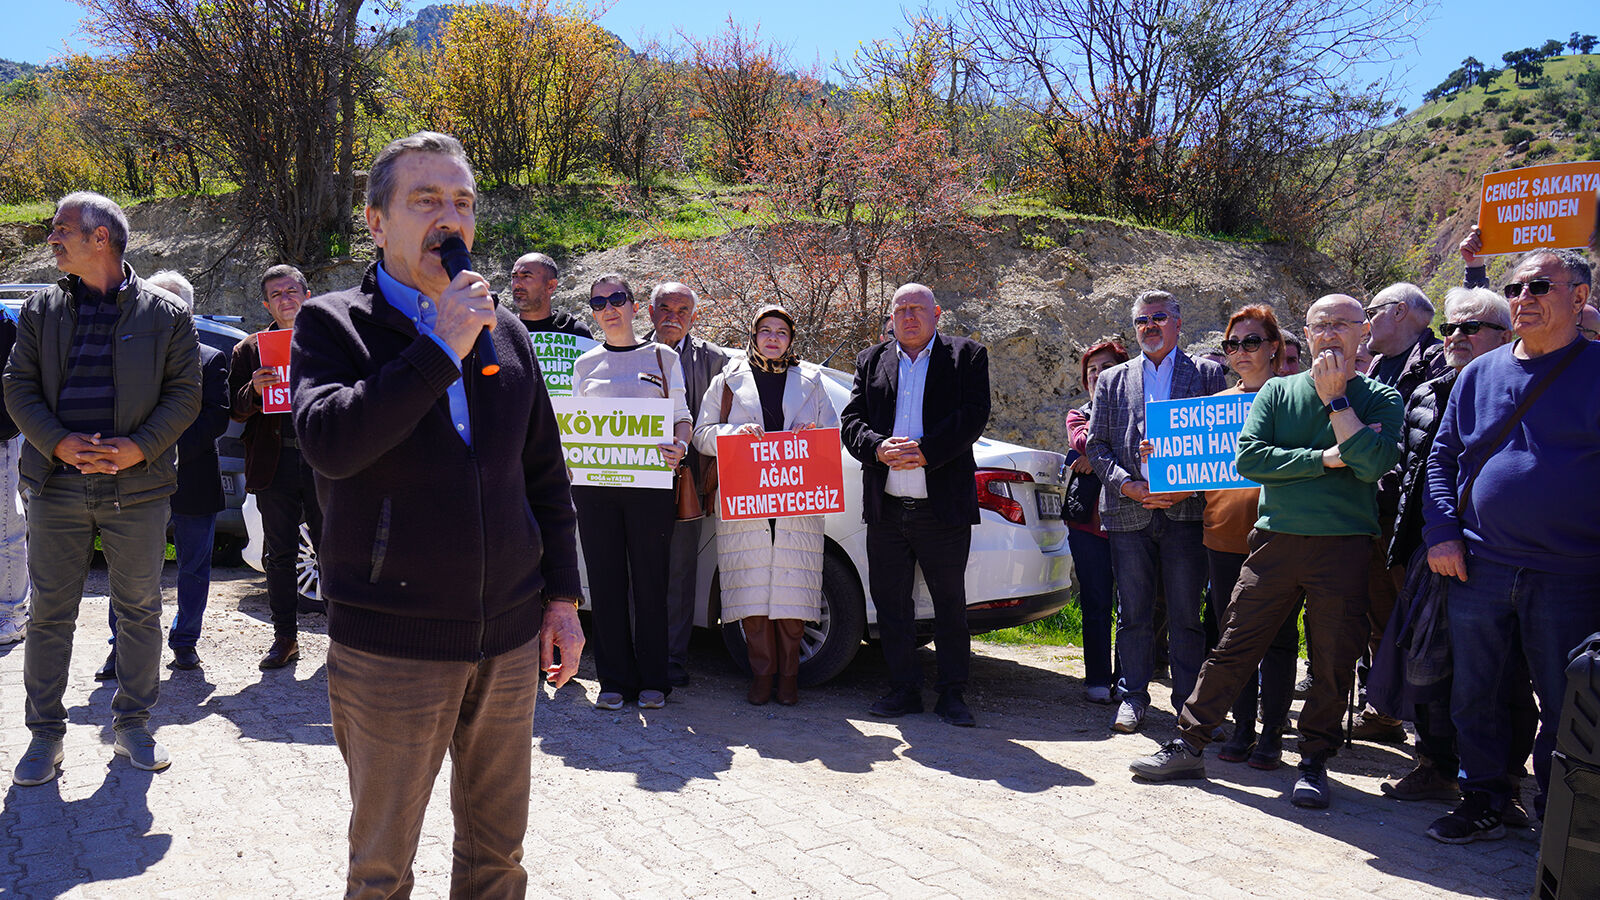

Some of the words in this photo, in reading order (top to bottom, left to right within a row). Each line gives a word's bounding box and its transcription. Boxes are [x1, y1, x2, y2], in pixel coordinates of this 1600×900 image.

[1485, 177, 1529, 203] CENGİZ
[1532, 173, 1600, 197] SAKARYA
[1497, 198, 1579, 223] VADİSİNDEN
[1513, 224, 1556, 245] DEFOL
[530, 333, 576, 347] AŞAM
[535, 346, 584, 359] LARIM
[556, 410, 665, 437] KÖYÜME
[750, 440, 781, 462] TEK
[784, 435, 809, 459] BİR
[1150, 434, 1203, 458] MADEN
[759, 463, 804, 488] AĞACI
[1166, 460, 1245, 485] OLMAYAC
[726, 485, 840, 516] VERMEYECEĞİZ
